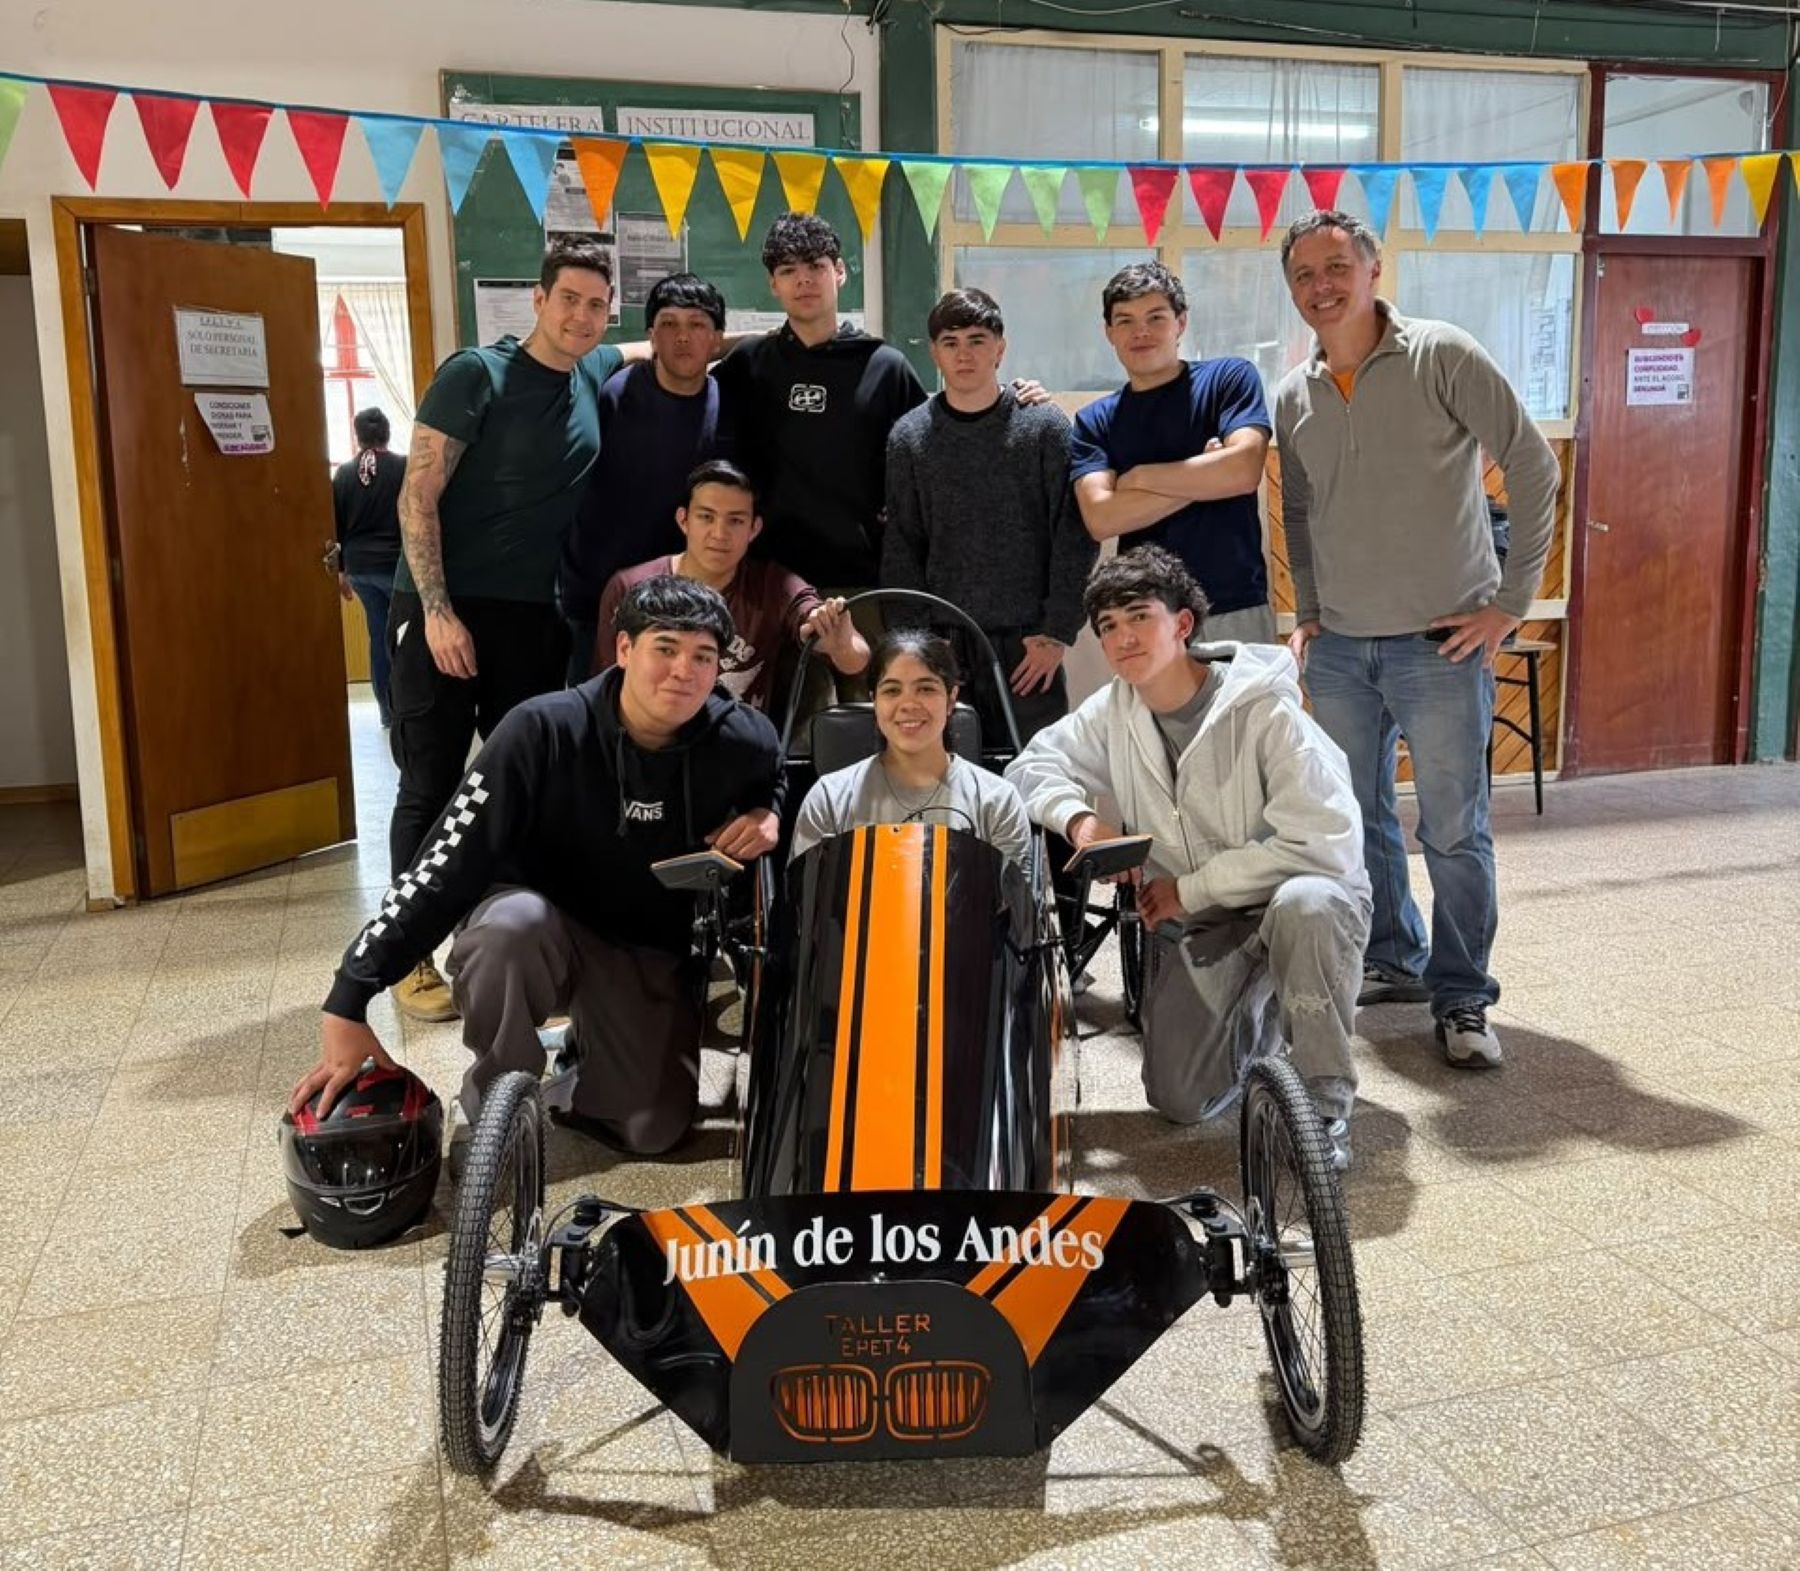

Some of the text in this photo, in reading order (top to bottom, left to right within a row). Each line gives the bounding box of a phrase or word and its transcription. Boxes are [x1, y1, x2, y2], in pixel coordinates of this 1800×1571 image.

[627, 115, 811, 140] INSTITUCIONAL
[623, 799, 664, 821] VANS
[662, 1213, 1105, 1287] Junín de los Andes
[823, 1313, 932, 1335] TALLER
